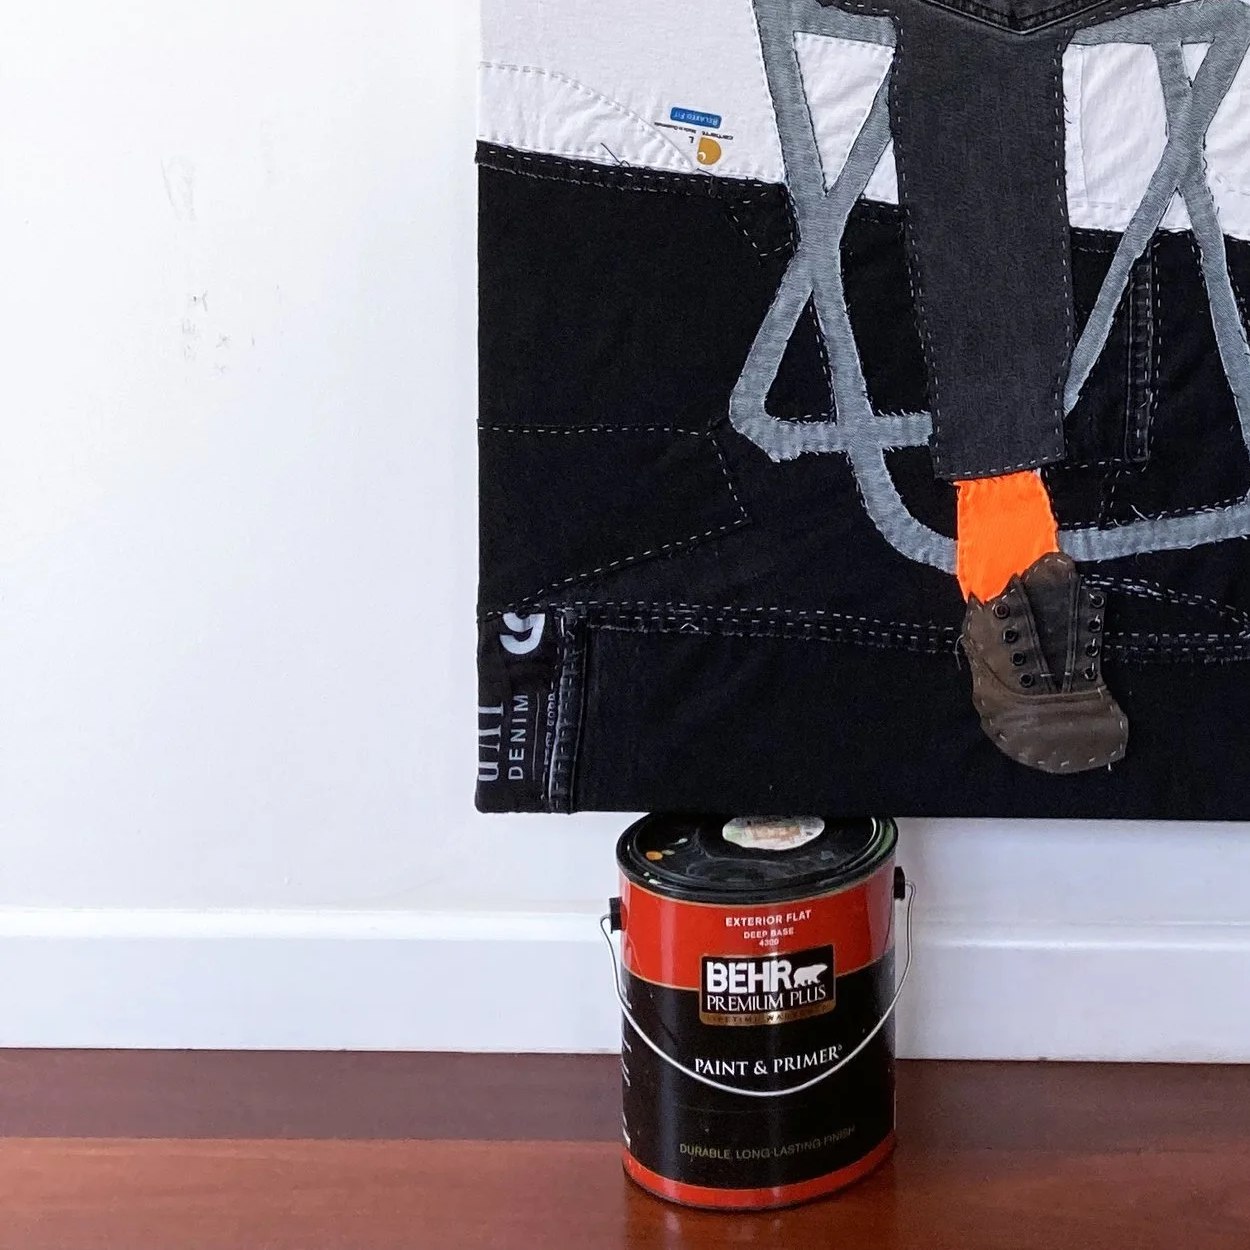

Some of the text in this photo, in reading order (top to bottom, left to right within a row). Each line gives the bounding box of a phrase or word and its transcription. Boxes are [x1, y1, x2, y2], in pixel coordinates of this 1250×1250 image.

[508, 694, 529, 780] DENIM
[725, 910, 812, 927] EXTERIOR FLAT
[743, 927, 794, 939] DEEP BASE
[706, 959, 793, 993] BEHR
[707, 984, 826, 1011] PREMIUM PLUS
[695, 1058, 748, 1076] PAINT
[753, 1060, 768, 1075] &
